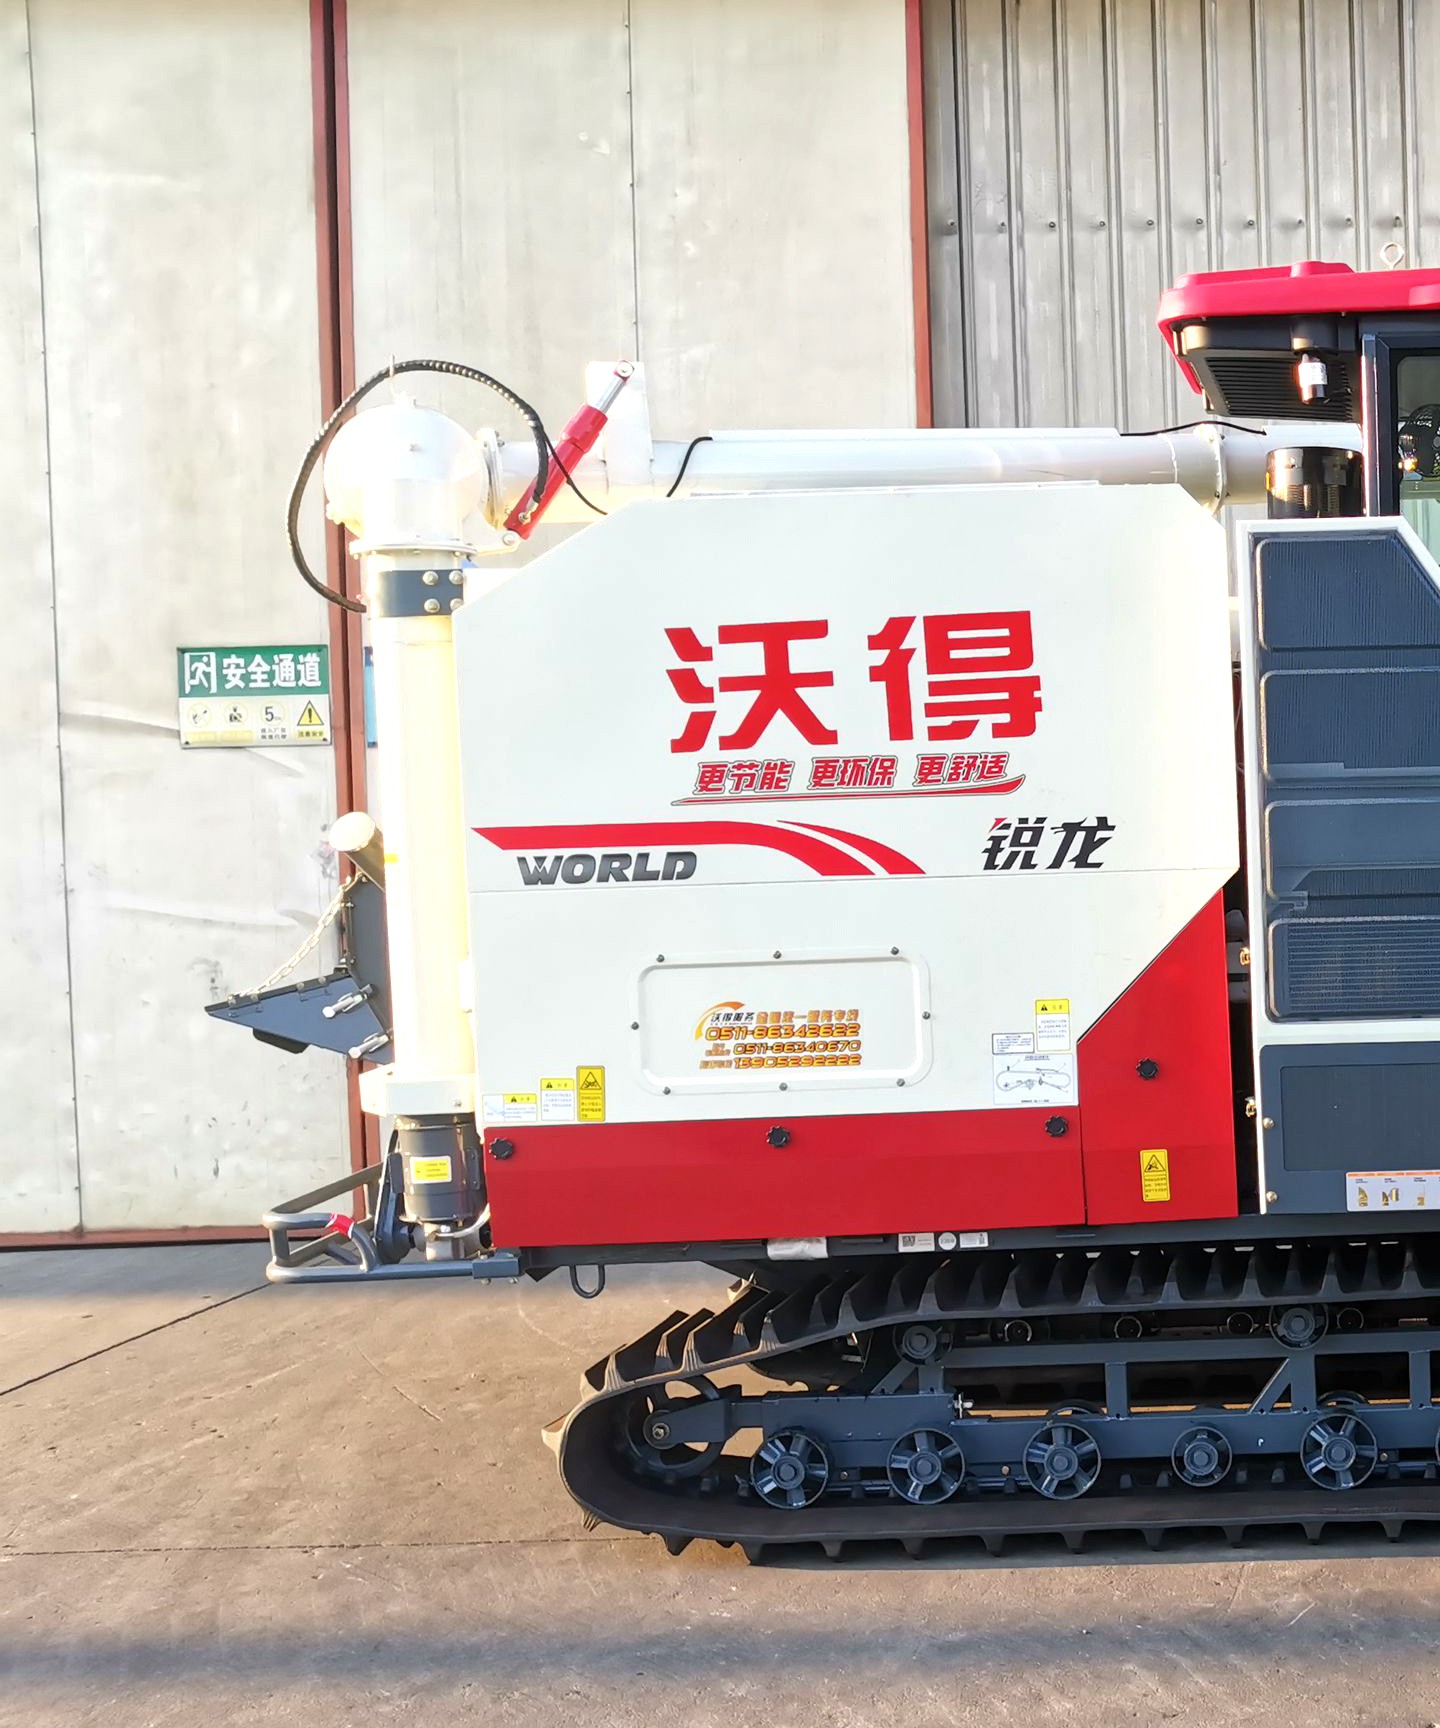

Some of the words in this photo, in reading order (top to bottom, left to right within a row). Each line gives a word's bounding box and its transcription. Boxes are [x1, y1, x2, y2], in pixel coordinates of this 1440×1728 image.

[222, 652, 322, 689] 安全通道
[664, 610, 1042, 753] 沃得
[264, 706, 274, 722] 5
[693, 758, 795, 794] 更节能
[807, 755, 898, 791] 更环保
[912, 751, 1009, 786] 更舒适
[981, 815, 1117, 871] 锐龙
[516, 851, 697, 886] WORLD
[705, 1023, 862, 1040] 0511-86342622
[733, 1040, 862, 1055] 0511-86340670
